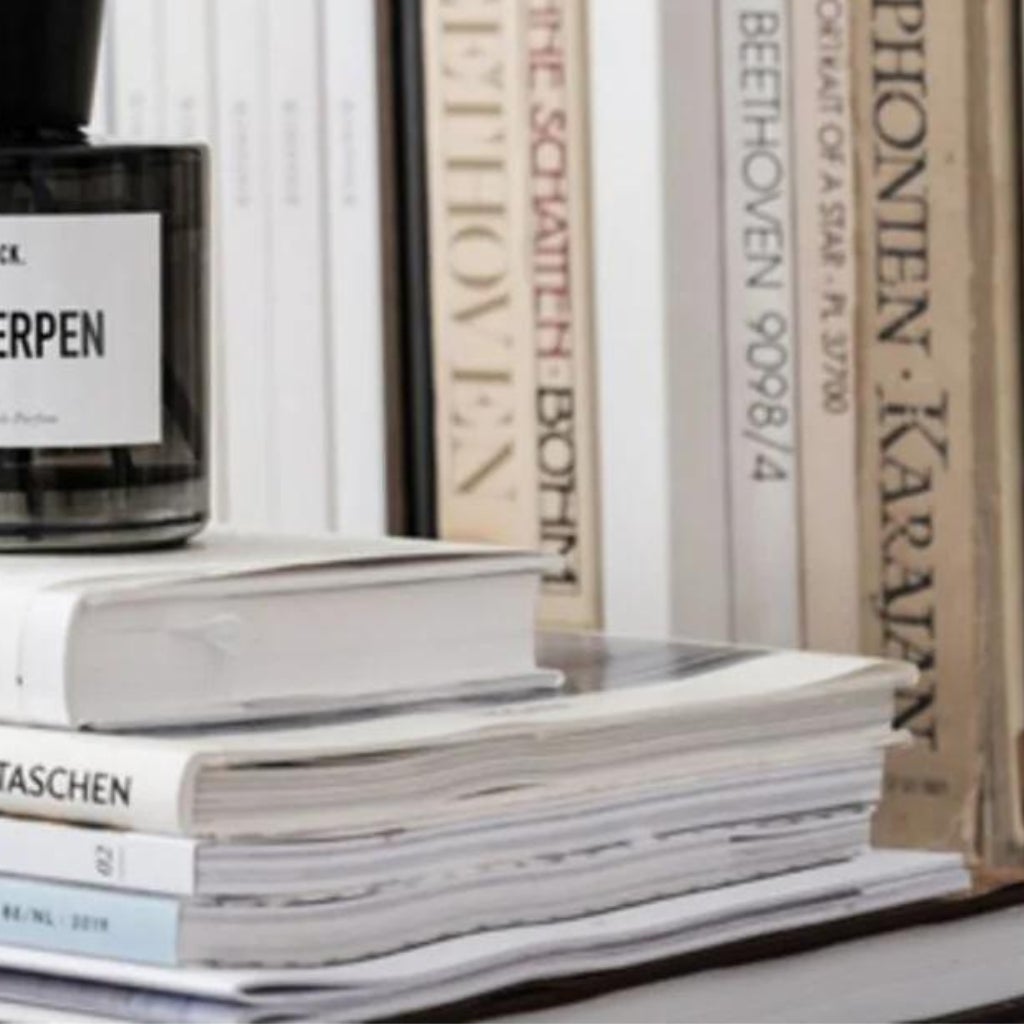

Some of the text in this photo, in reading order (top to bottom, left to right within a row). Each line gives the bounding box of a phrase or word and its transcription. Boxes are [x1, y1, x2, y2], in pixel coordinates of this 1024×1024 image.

[739, 10, 784, 289] BEETHOVEN
[818, 123, 846, 165] OF
[819, 167, 844, 194] A
[530, 101, 575, 359] SCHATTEN
[819, 200, 846, 268] STAR
[742, 311, 794, 482] 9098/4
[870, 390, 949, 752] KARAJAN
